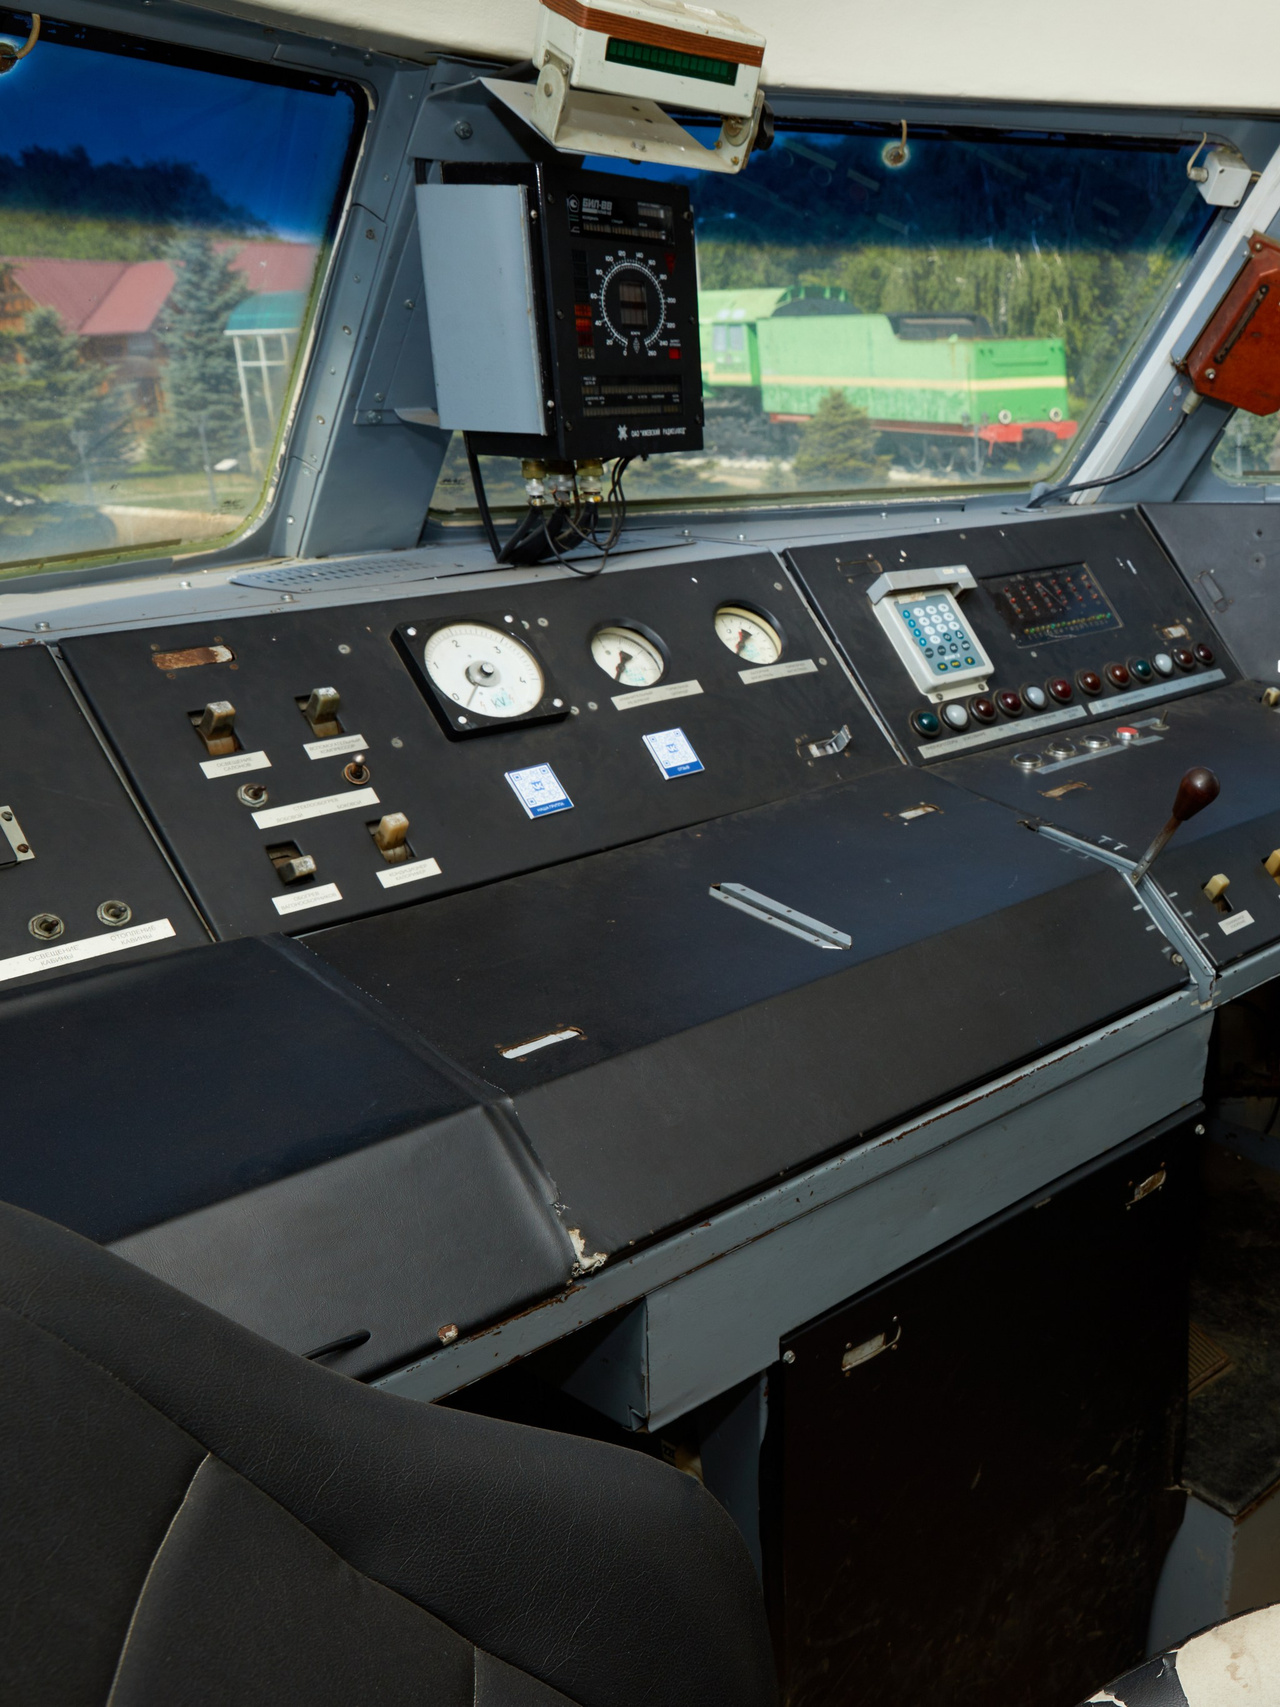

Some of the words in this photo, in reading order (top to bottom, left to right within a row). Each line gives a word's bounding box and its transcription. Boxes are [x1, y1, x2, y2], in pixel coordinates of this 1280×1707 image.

[451, 639, 461, 648] 2
[493, 646, 502, 654] 3
[433, 661, 440, 669] 1
[519, 677, 527, 685] 4
[451, 692, 460, 701] 0
[216, 757, 252, 768] ОСВЕЩЕНИЕ
[223, 763, 251, 771] САЛОНОВ
[293, 797, 339, 811] СТЕКЛООБОГРЕВ
[293, 891, 320, 902] ОБОГРЕВ
[110, 925, 156, 942] ОТОПЛЕНИЕ
[120, 933, 153, 946] КАБИНЫ
[28, 944, 79, 962] ОСВЕЩЕНИЕ
[40, 953, 74, 967] КАБИНЫ
